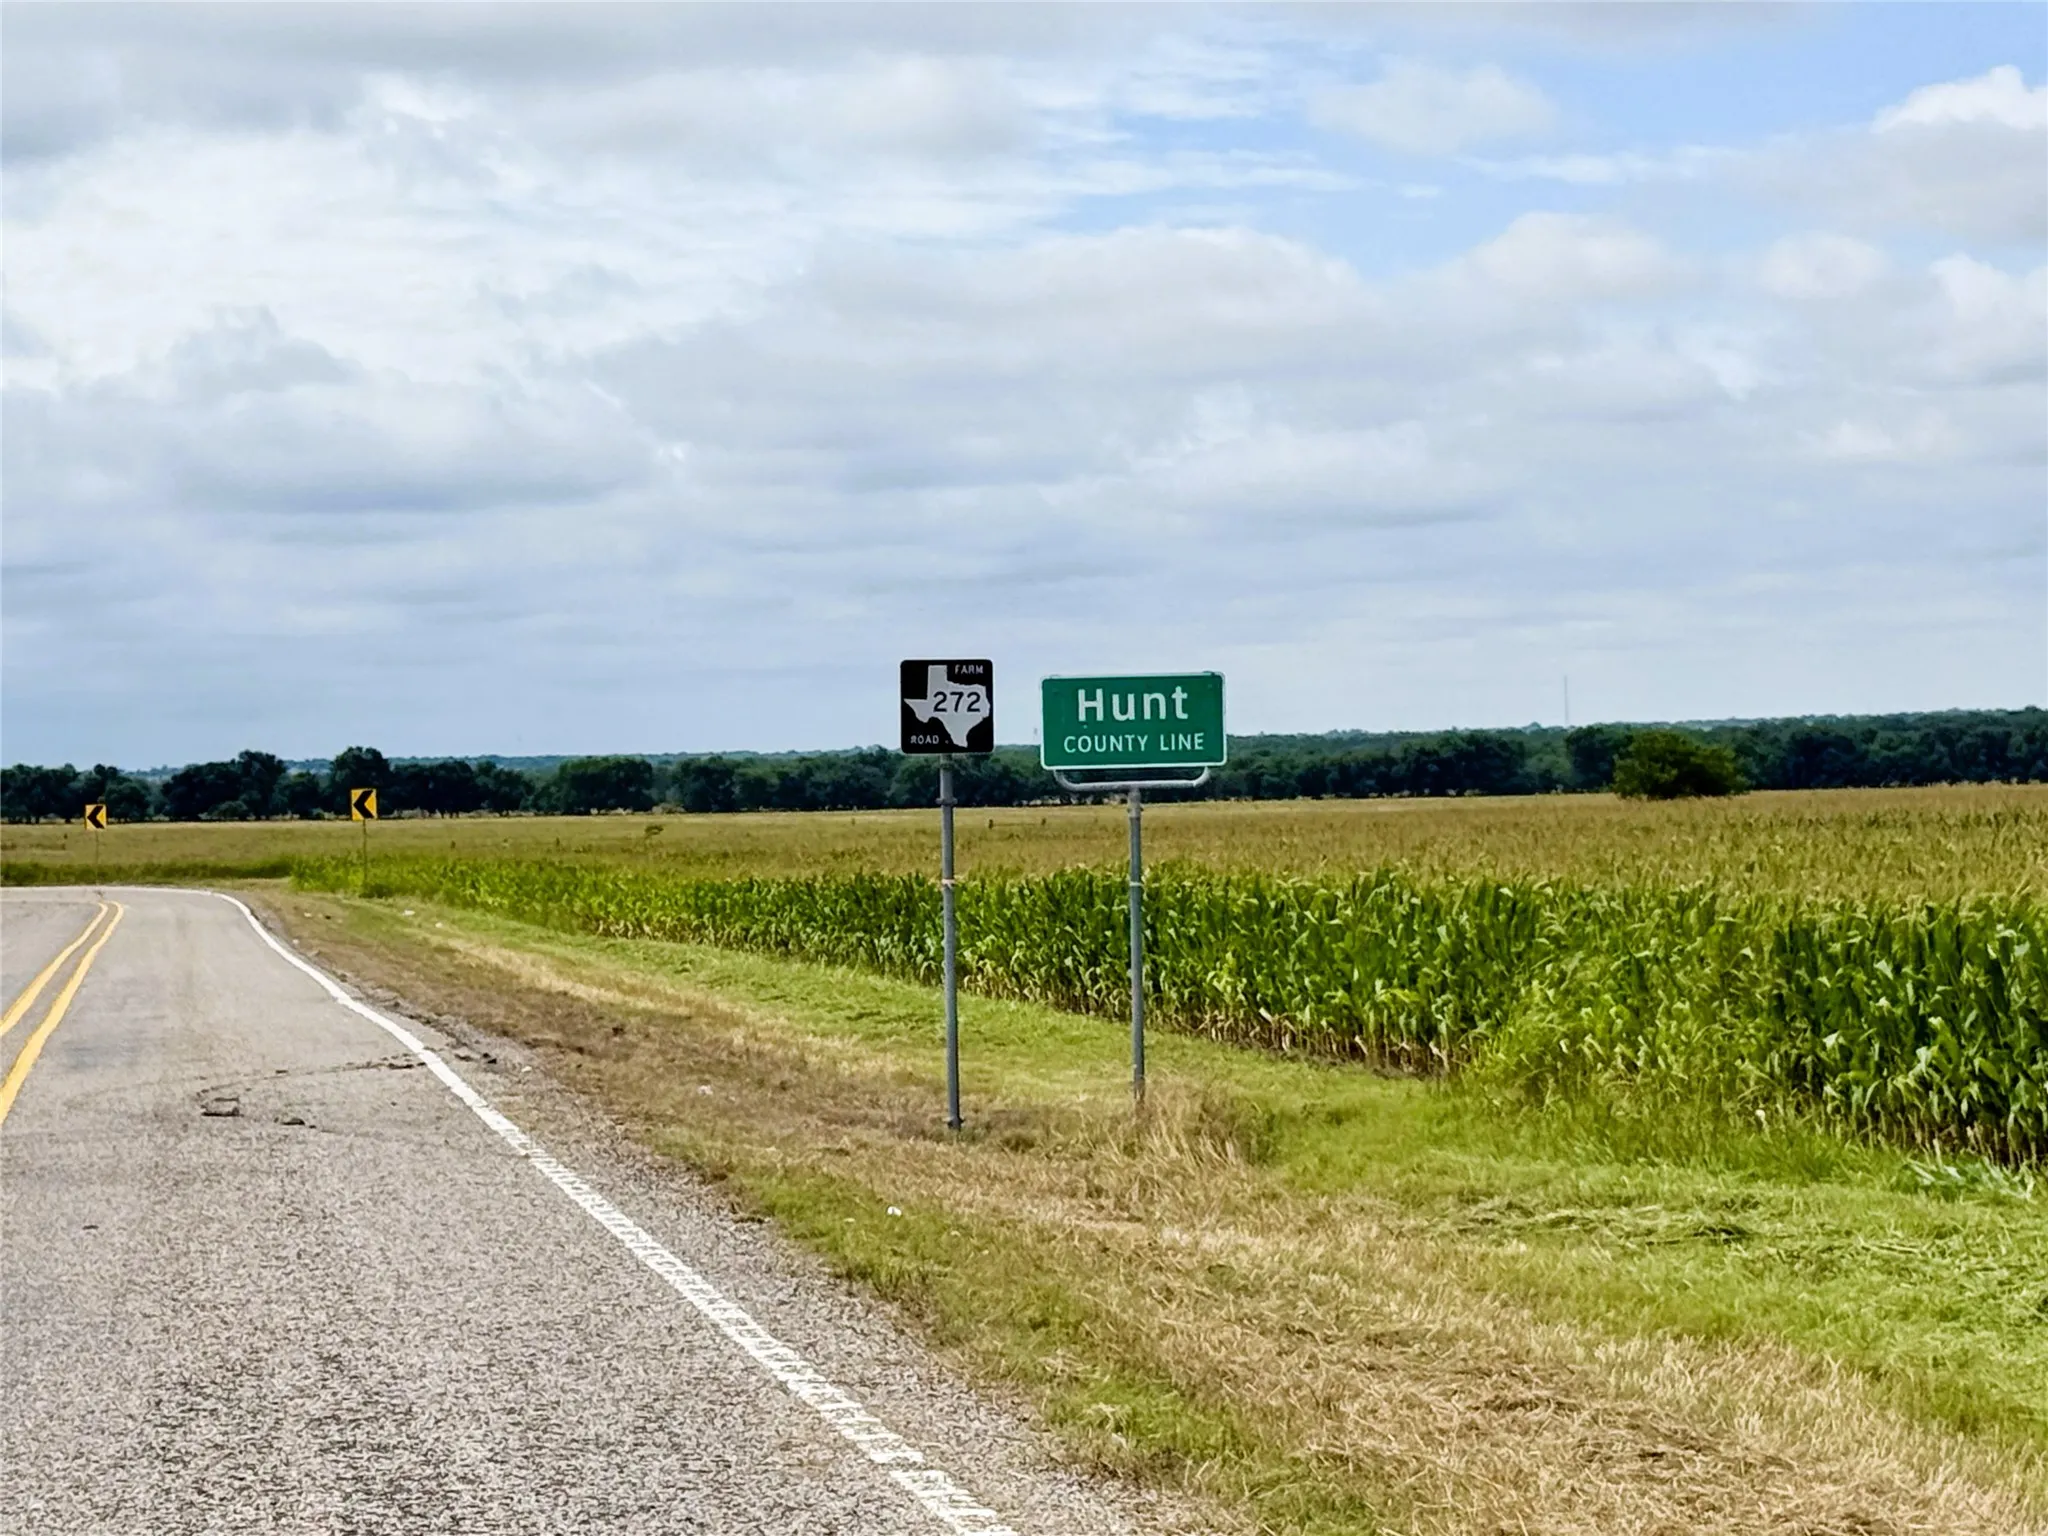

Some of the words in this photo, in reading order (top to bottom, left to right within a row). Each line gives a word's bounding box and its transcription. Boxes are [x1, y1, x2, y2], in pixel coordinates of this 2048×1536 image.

[954, 664, 984, 674] FARM
[933, 691, 981, 713] 272
[1077, 685, 1189, 722] Hunt
[910, 735, 939, 744] ROAD
[1063, 734, 1149, 753] COUNTY
[1159, 732, 1205, 751] LINE
